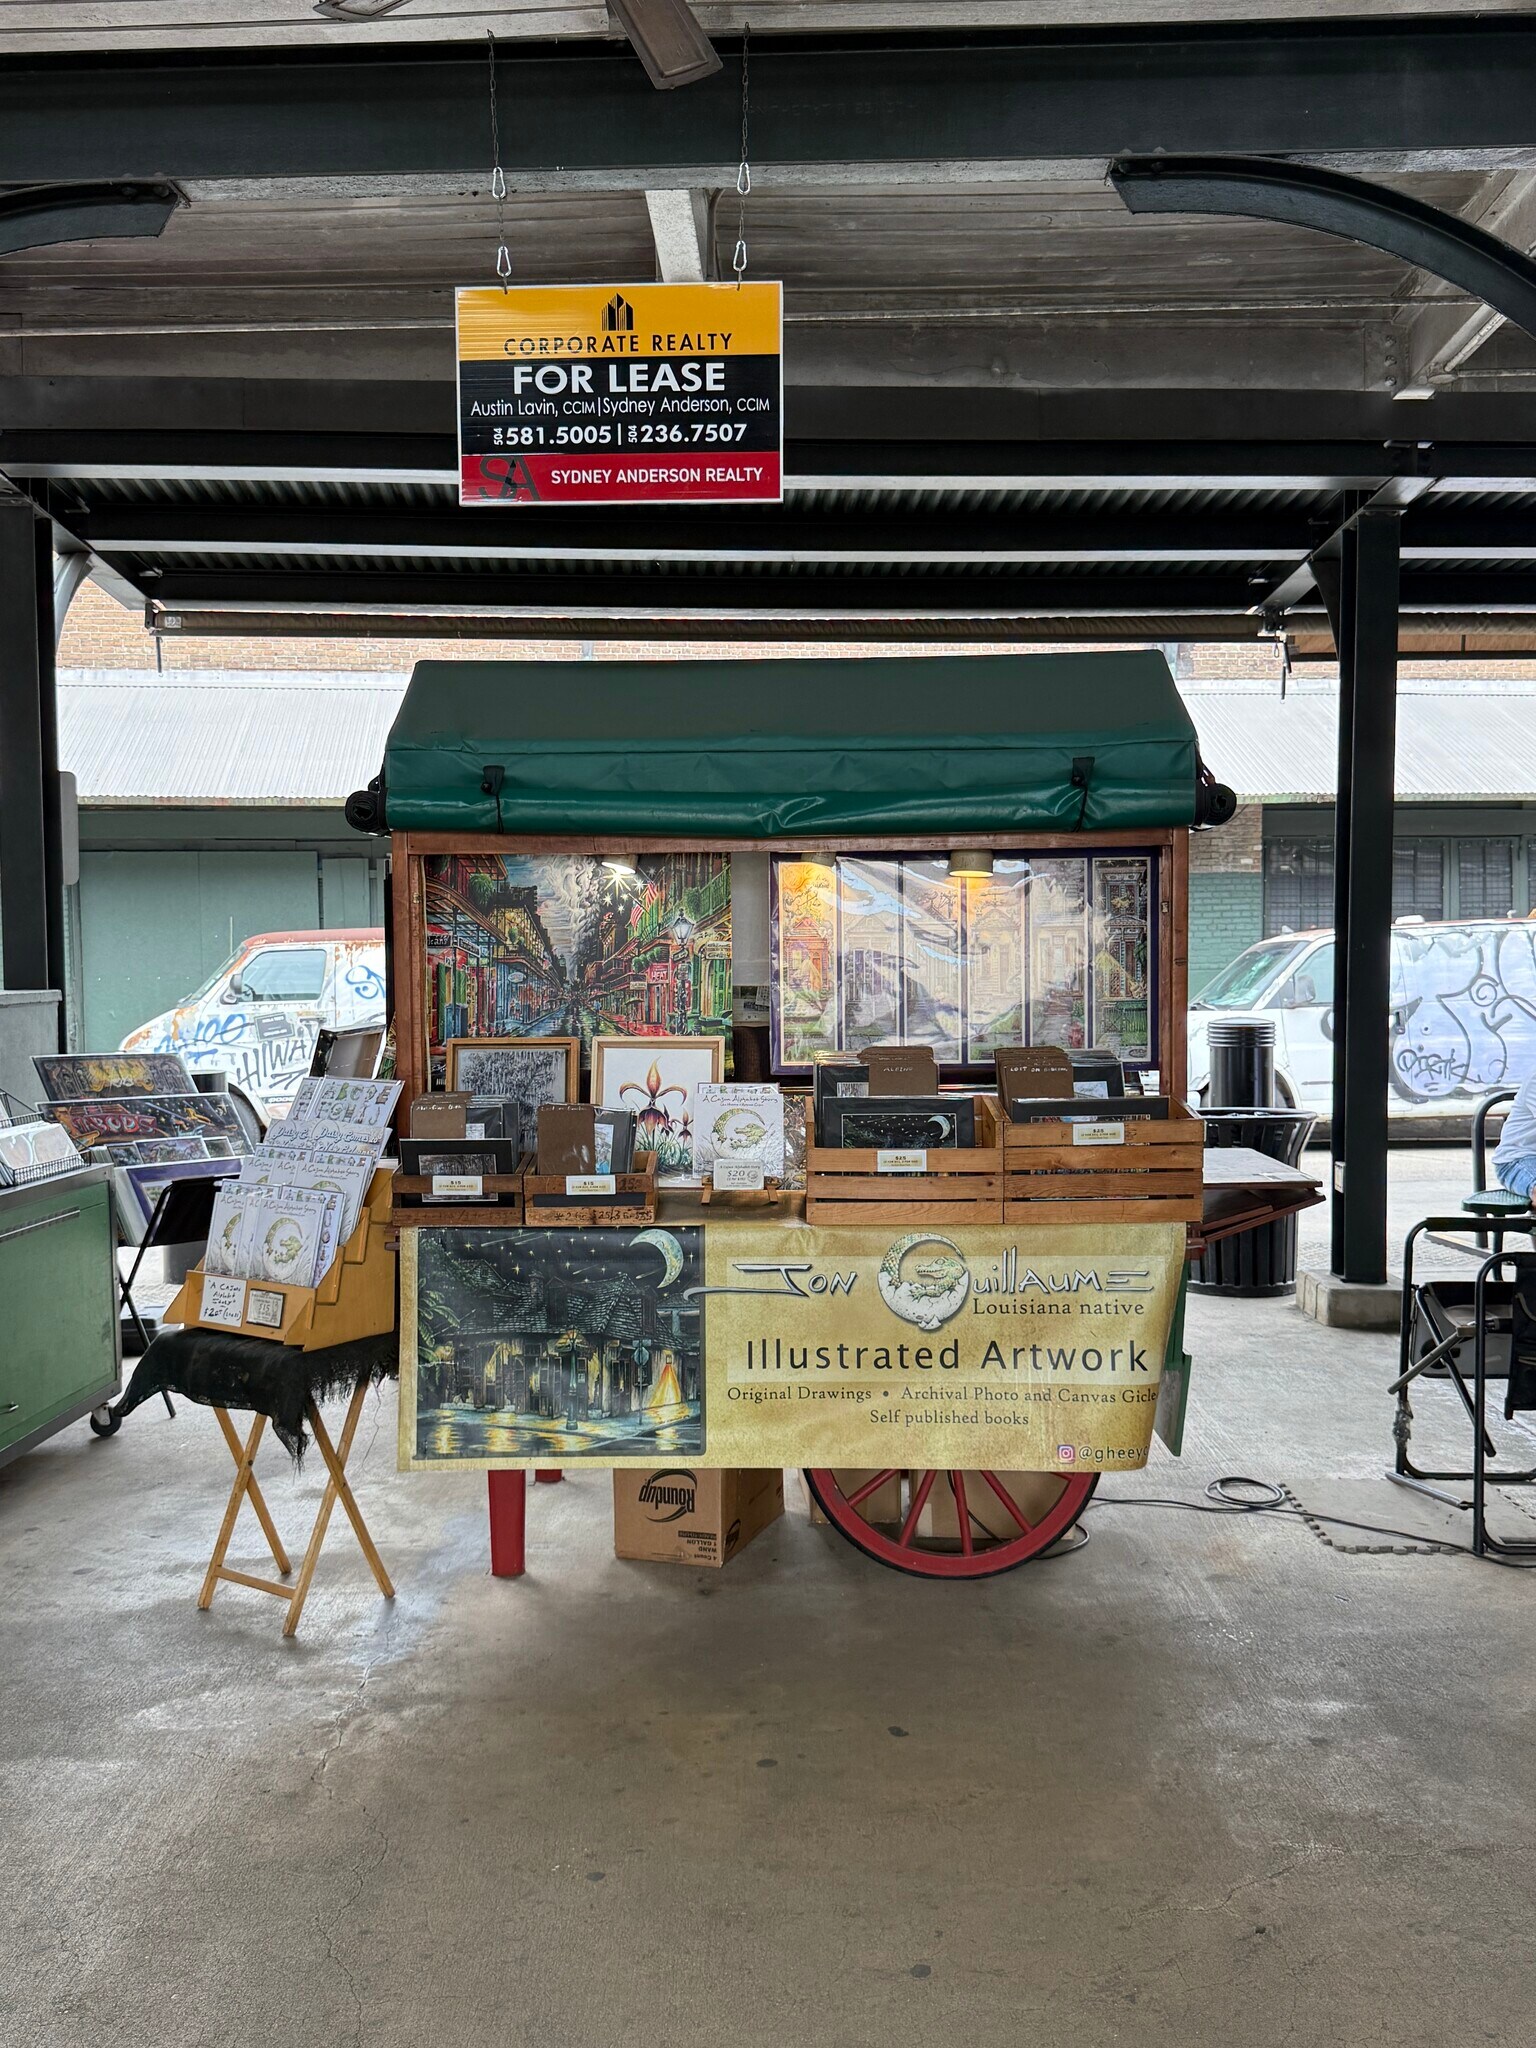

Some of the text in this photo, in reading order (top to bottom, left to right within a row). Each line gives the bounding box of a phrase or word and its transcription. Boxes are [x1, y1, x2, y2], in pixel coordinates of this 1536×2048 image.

[504, 333, 732, 356] CORPORATE REALTY
[513, 363, 725, 395] FOR LEASE
[471, 399, 513, 416] Austin
[518, 399, 558, 417] Lavin,
[660, 396, 733, 415] Anderson,
[737, 398, 770, 412] CCIM
[494, 423, 747, 446] 504 581.5005 504 236.7507
[551, 467, 763, 484] SYDNEY ANDERSON REALTY
[732, 1094, 759, 1102] Alphabet
[760, 1095, 778, 1104] Story
[314, 1128, 343, 1144] Daisy
[344, 1131, 369, 1144] Comes
[973, 1298, 1145, 1316] Louisiana native
[747, 1339, 1148, 1372] Illustrated Artwork
[727, 1386, 792, 1403] Original
[798, 1386, 872, 1403] Drawings
[901, 1386, 968, 1400] Archival
[974, 1386, 1019, 1402] Photo
[1024, 1388, 1052, 1402] and
[1058, 1388, 1117, 1402] Canvas
[870, 1409, 1029, 1428] Self published books
[638, 1478, 696, 1513] Roundup
